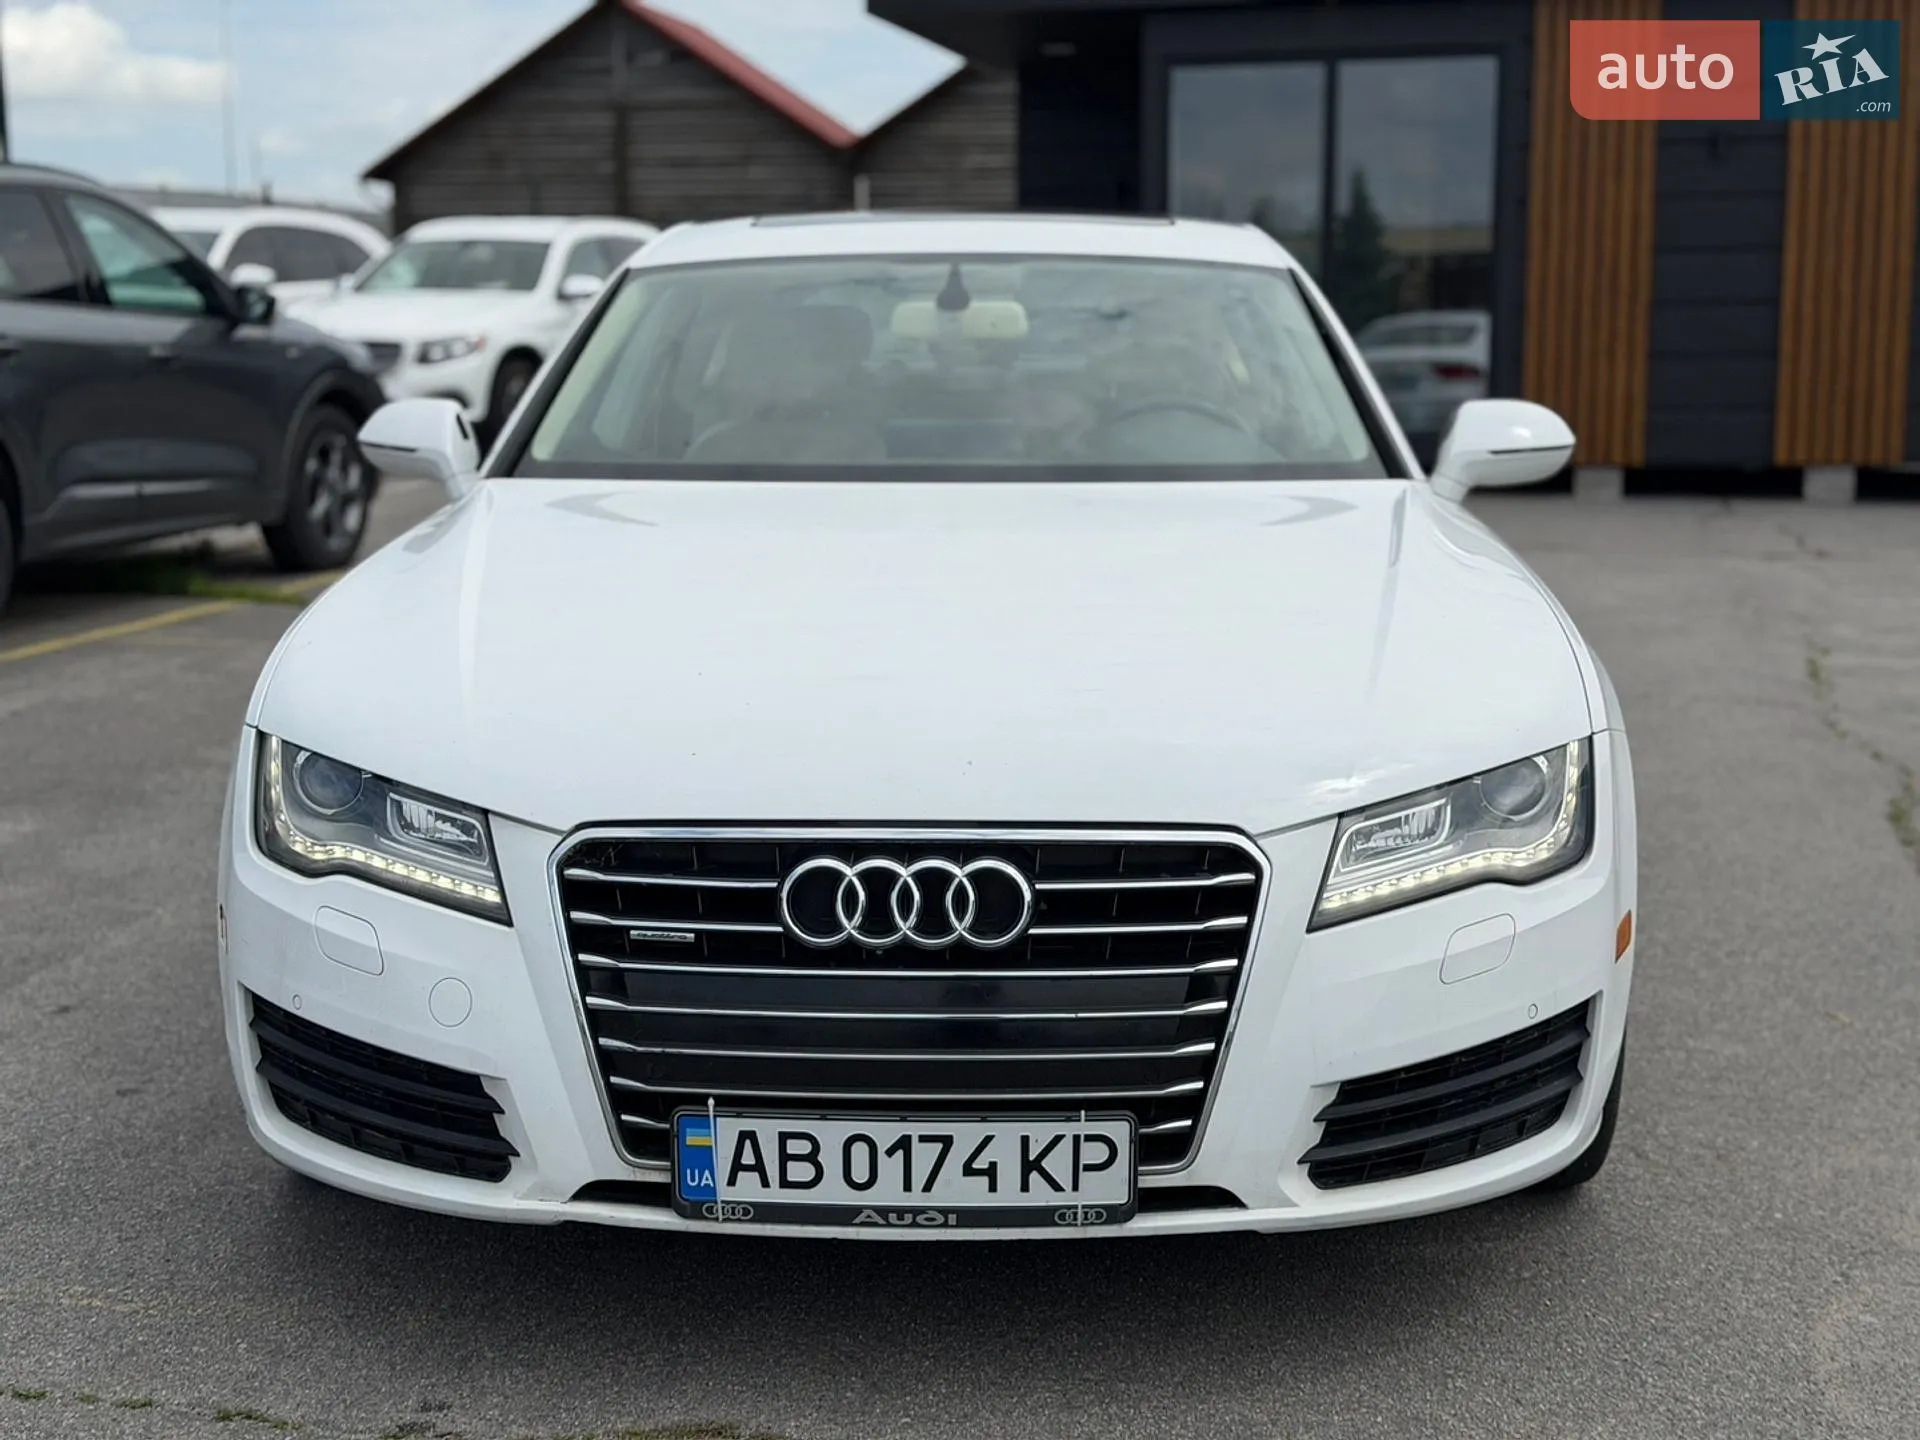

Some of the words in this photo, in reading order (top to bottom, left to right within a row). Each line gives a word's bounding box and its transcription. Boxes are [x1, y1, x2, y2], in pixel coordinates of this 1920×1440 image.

[726, 1129, 825, 1190] AB
[842, 1132, 998, 1194] 0174
[1019, 1133, 1119, 1194] KP
[686, 1168, 714, 1188] UA
[851, 1208, 958, 1227] Audi
